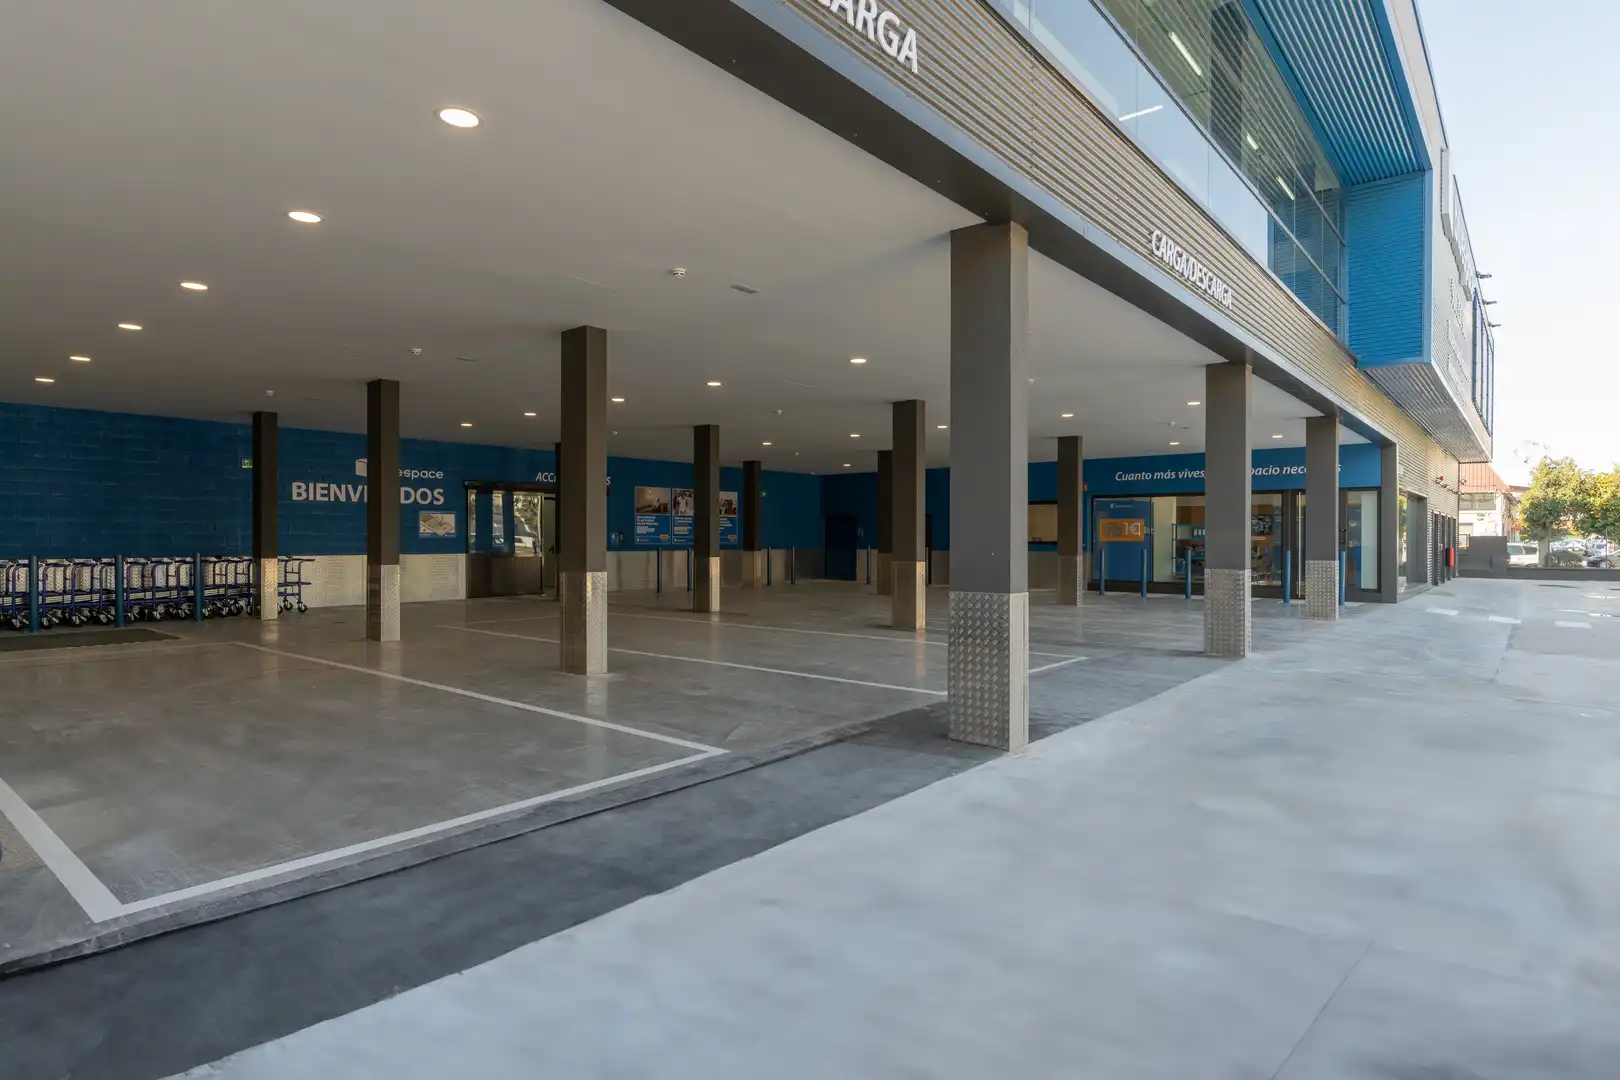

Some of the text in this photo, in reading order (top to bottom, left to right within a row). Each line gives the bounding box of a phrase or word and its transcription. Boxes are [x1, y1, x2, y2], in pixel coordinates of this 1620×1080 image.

[816, 0, 918, 74] ARGA
[1151, 229, 1233, 310] CARGA/DESCARGA
[1115, 471, 1152, 481] Cuanto
[1153, 469, 1176, 480] más
